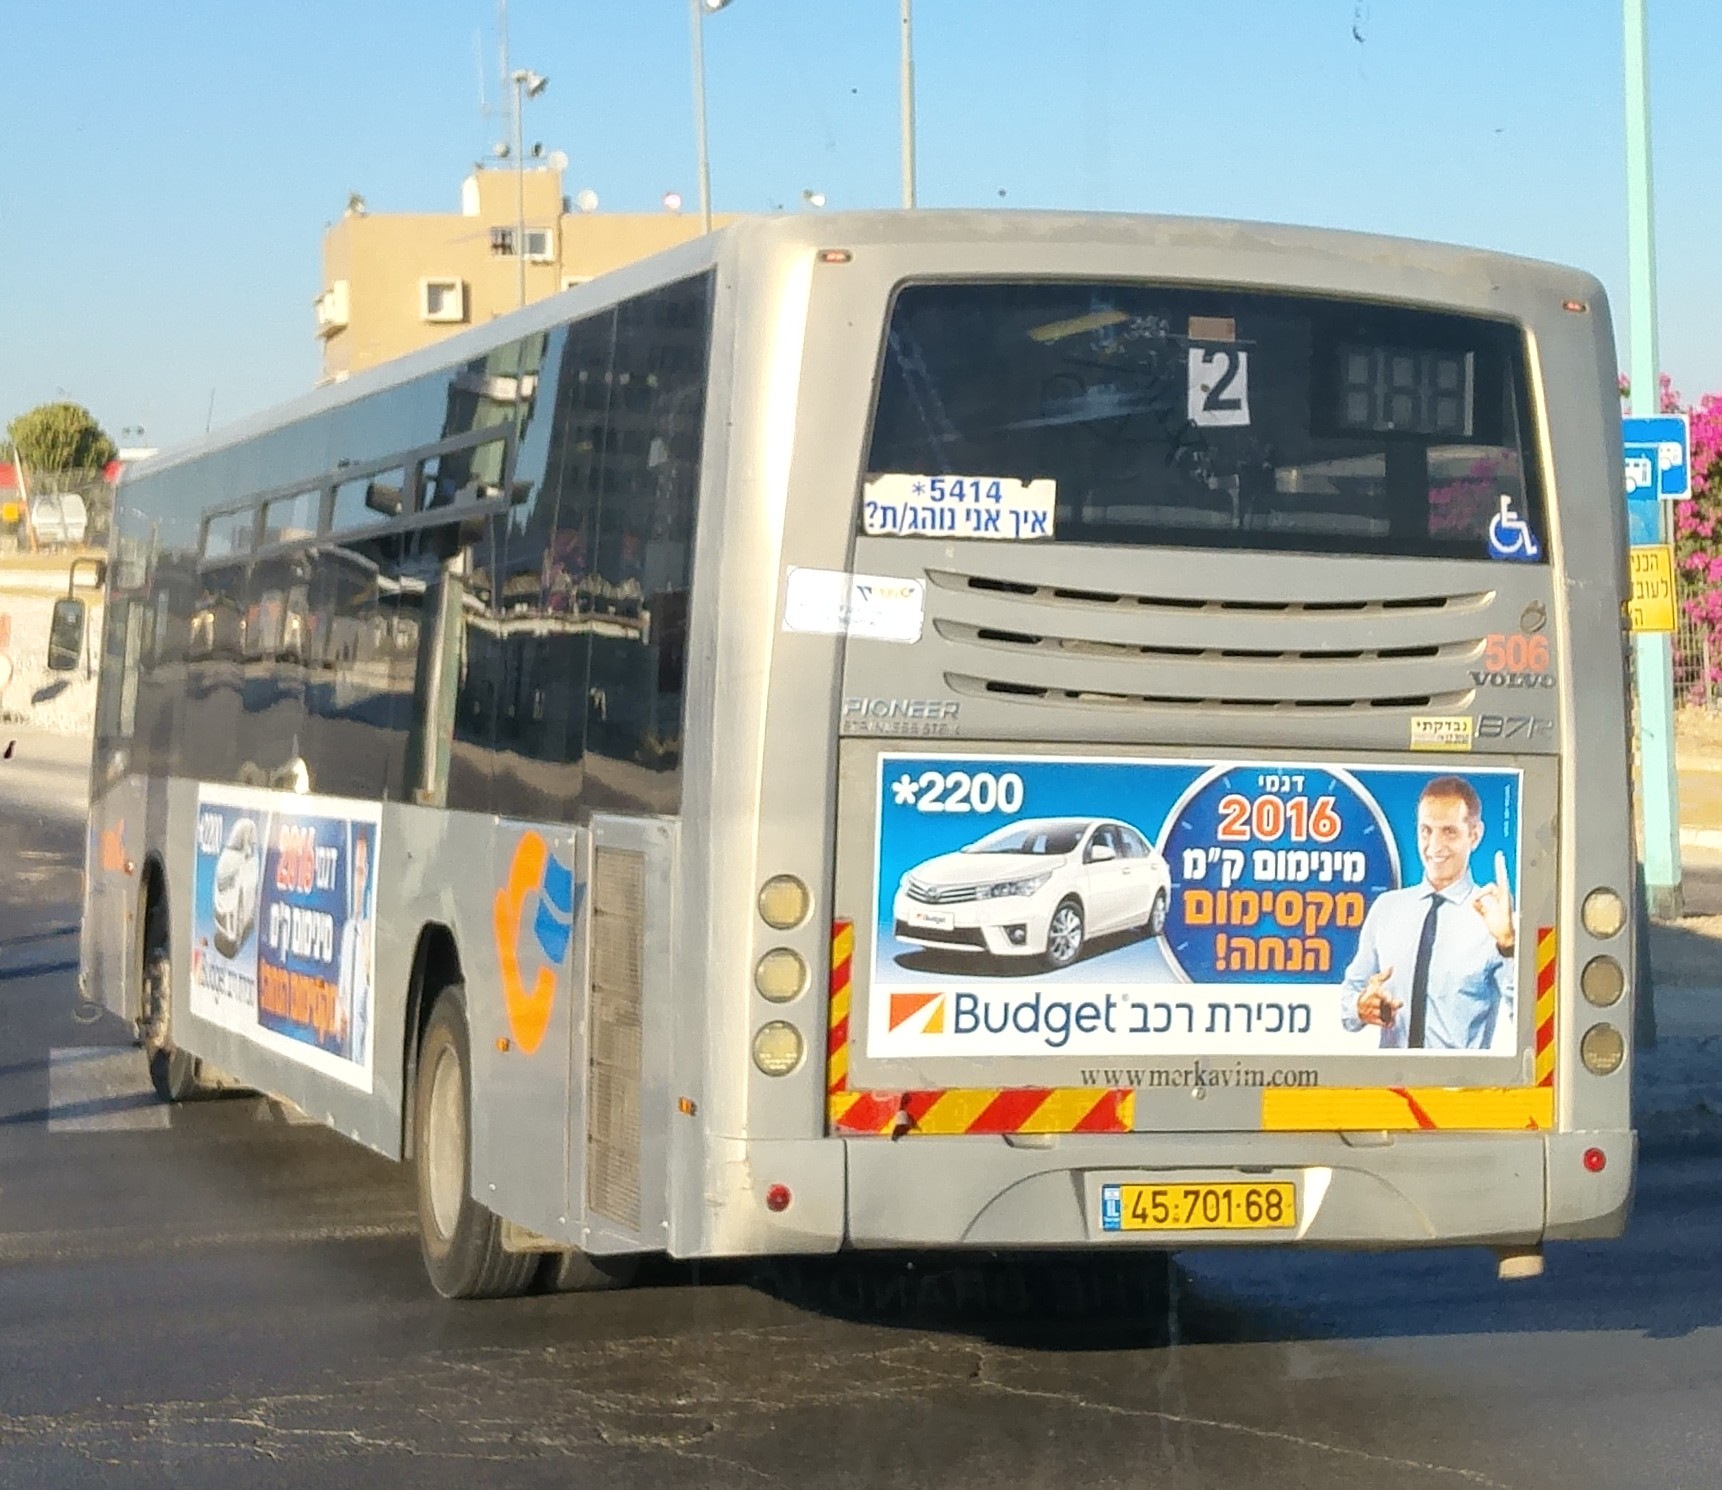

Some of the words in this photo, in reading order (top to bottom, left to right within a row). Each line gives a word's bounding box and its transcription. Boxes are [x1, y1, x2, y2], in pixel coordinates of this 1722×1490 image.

[1202, 345, 1241, 411] 2
[965, 507, 1001, 533] אני
[1009, 509, 1047, 538] איך
[1485, 634, 1549, 671] 506
[1467, 671, 1557, 689] VOLVO
[844, 698, 960, 720] PIONEER
[1416, 721, 1467, 734] נבדקתי
[1258, 775, 1305, 792] דגמי
[1217, 794, 1342, 842] 2016
[1253, 850, 1366, 882] מינימום
[1183, 889, 1365, 936] מקסימום
[1216, 933, 1331, 971] הנחה!
[954, 992, 1117, 1047] Budget
[1129, 1001, 1194, 1033] רכב
[1205, 1002, 1312, 1033] מכירת
